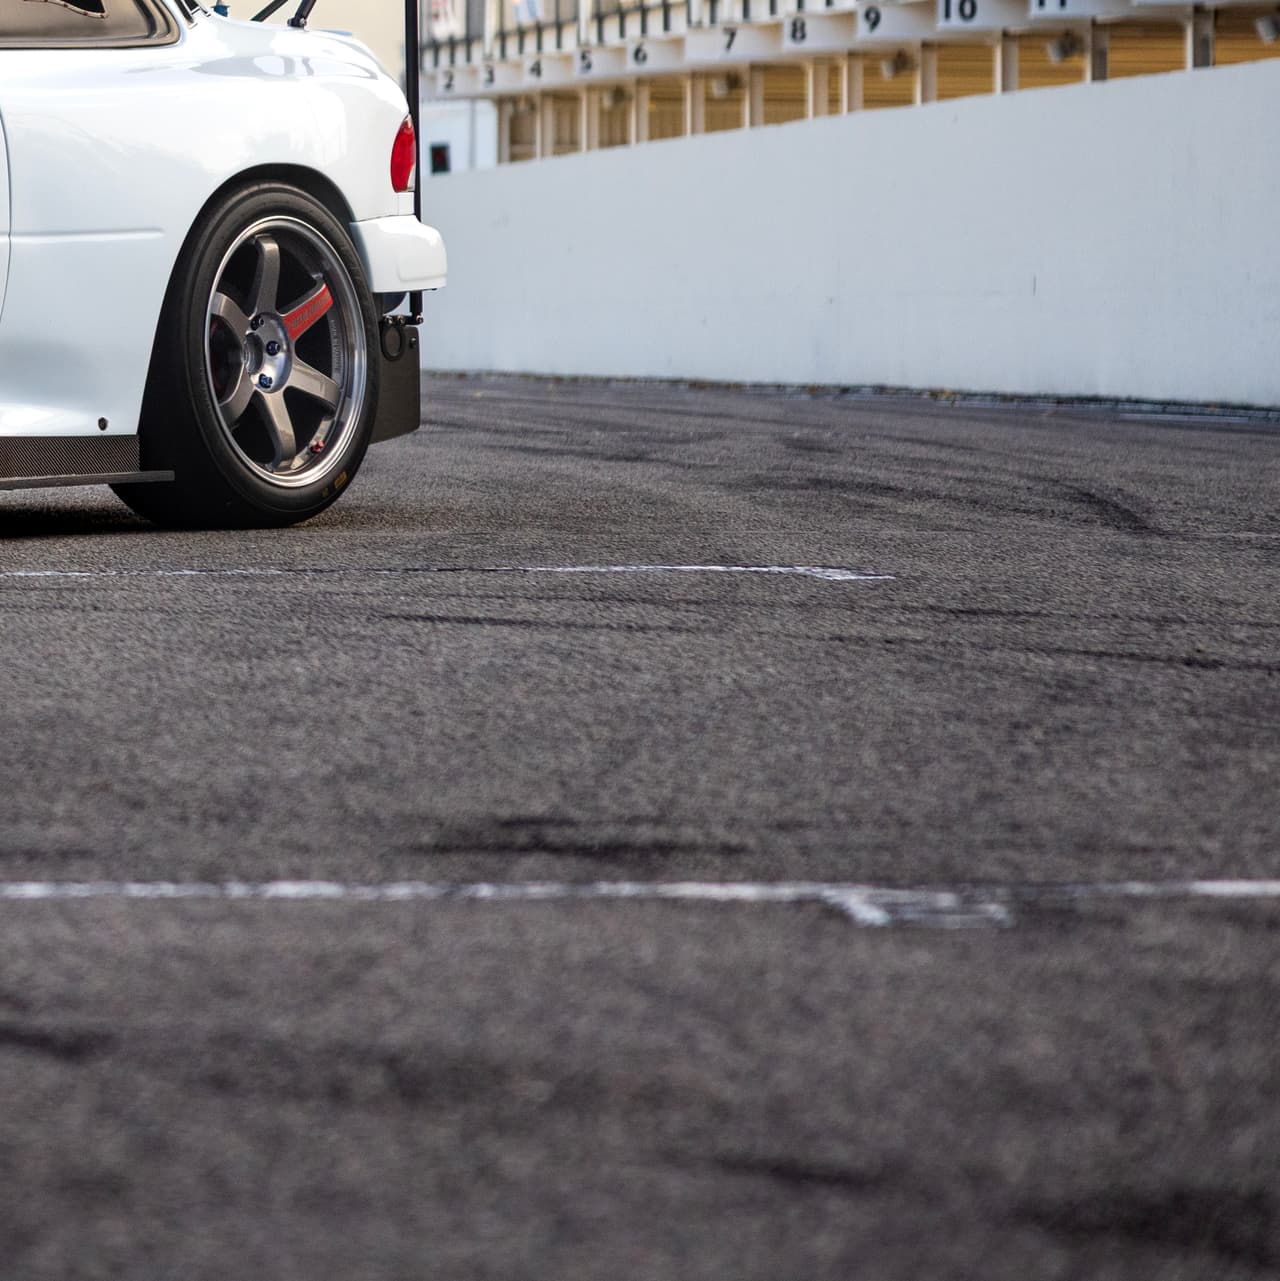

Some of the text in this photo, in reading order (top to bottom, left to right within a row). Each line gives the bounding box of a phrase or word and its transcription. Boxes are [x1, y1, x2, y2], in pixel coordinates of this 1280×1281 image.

[790, 17, 807, 42] 8
[863, 6, 881, 32] 9
[723, 27, 738, 52] 7
[580, 50, 593, 72] 5
[633, 46, 648, 64] 6
[529, 60, 543, 79] 4
[444, 71, 455, 91] 2
